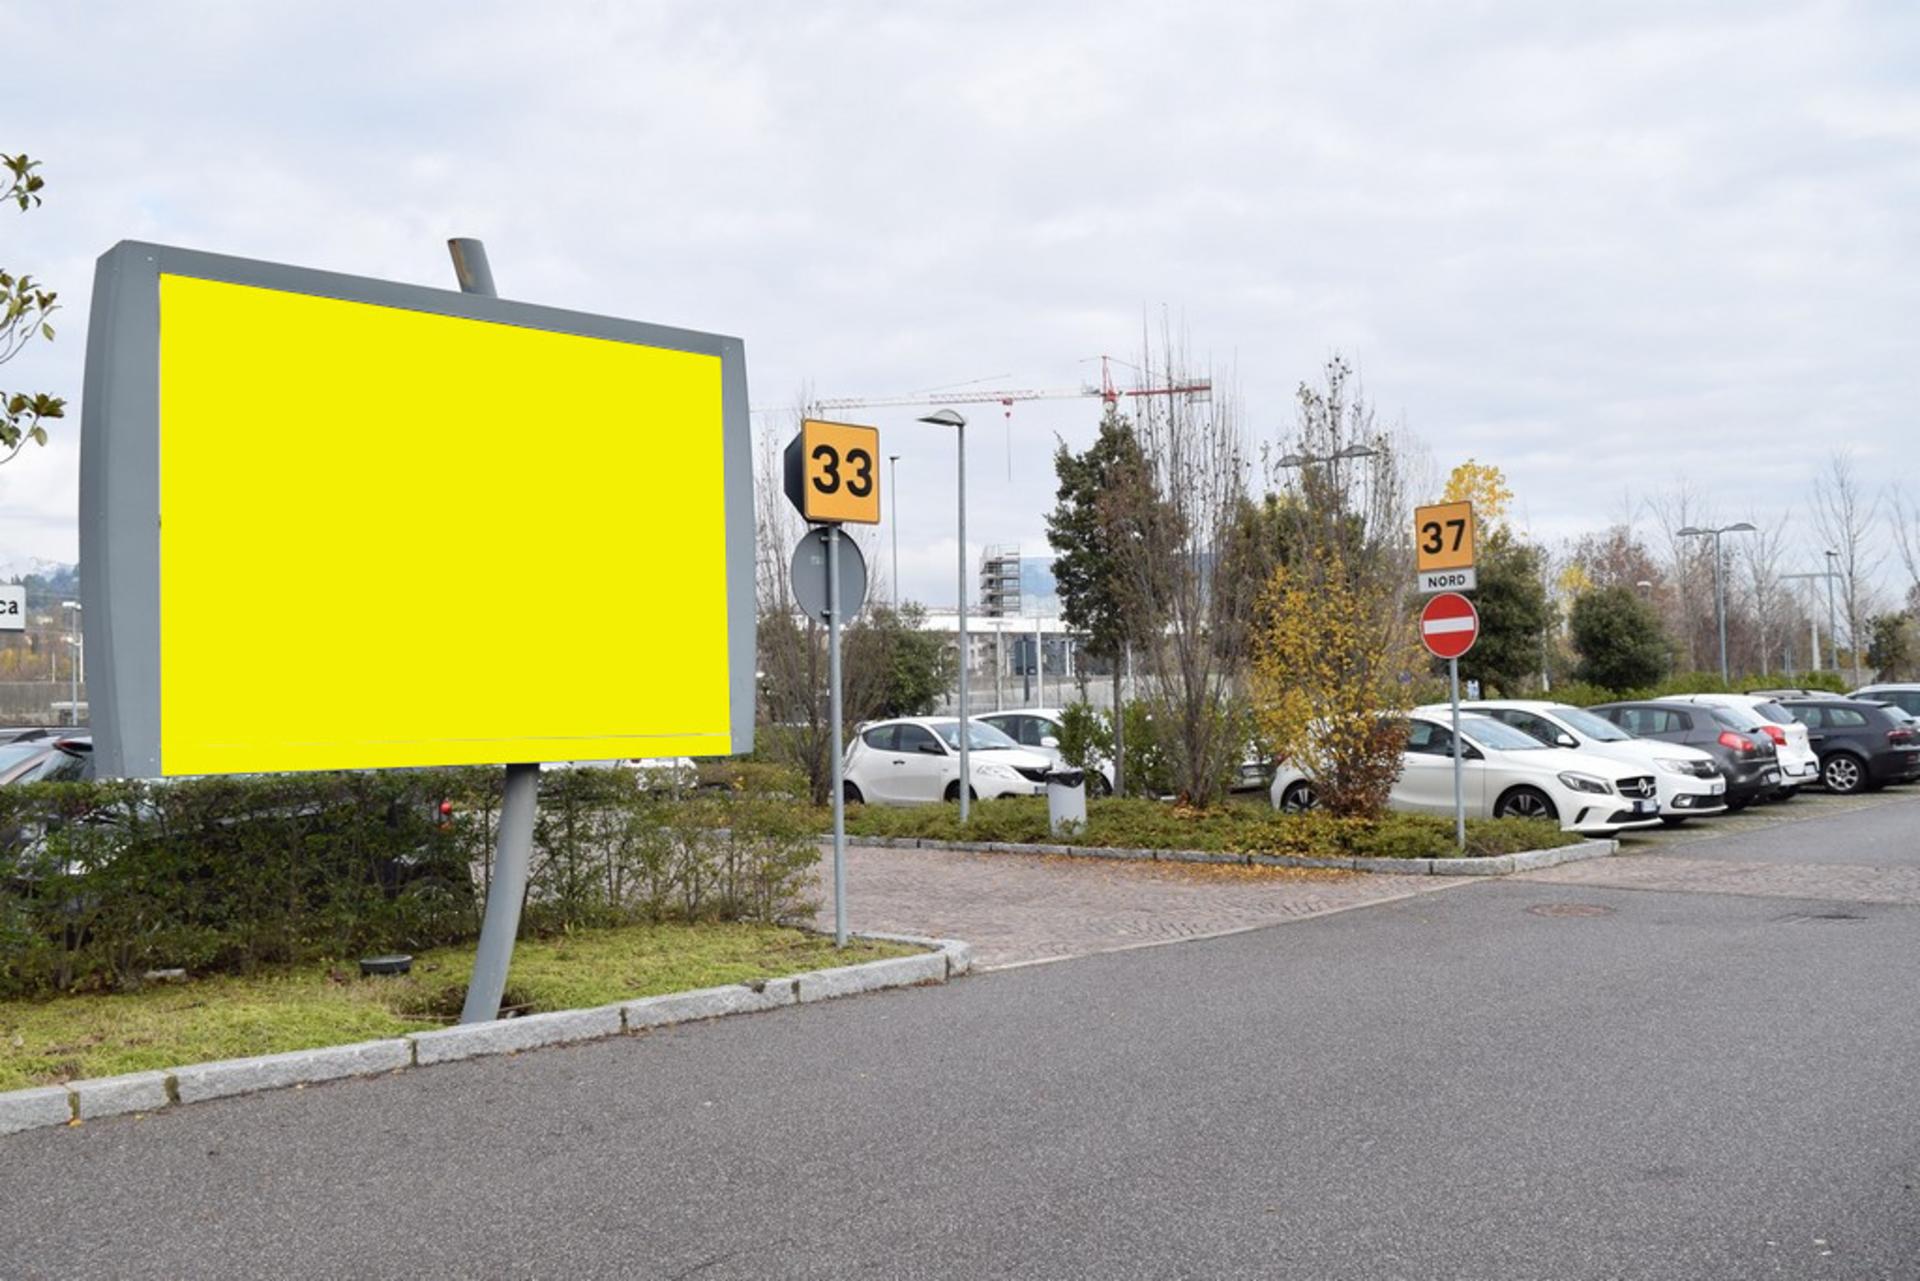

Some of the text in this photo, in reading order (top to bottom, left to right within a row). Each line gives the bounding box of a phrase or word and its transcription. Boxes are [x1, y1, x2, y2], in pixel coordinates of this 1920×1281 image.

[811, 444, 873, 498] 33
[1422, 519, 1466, 554] 37
[1428, 574, 1466, 588] NORD
